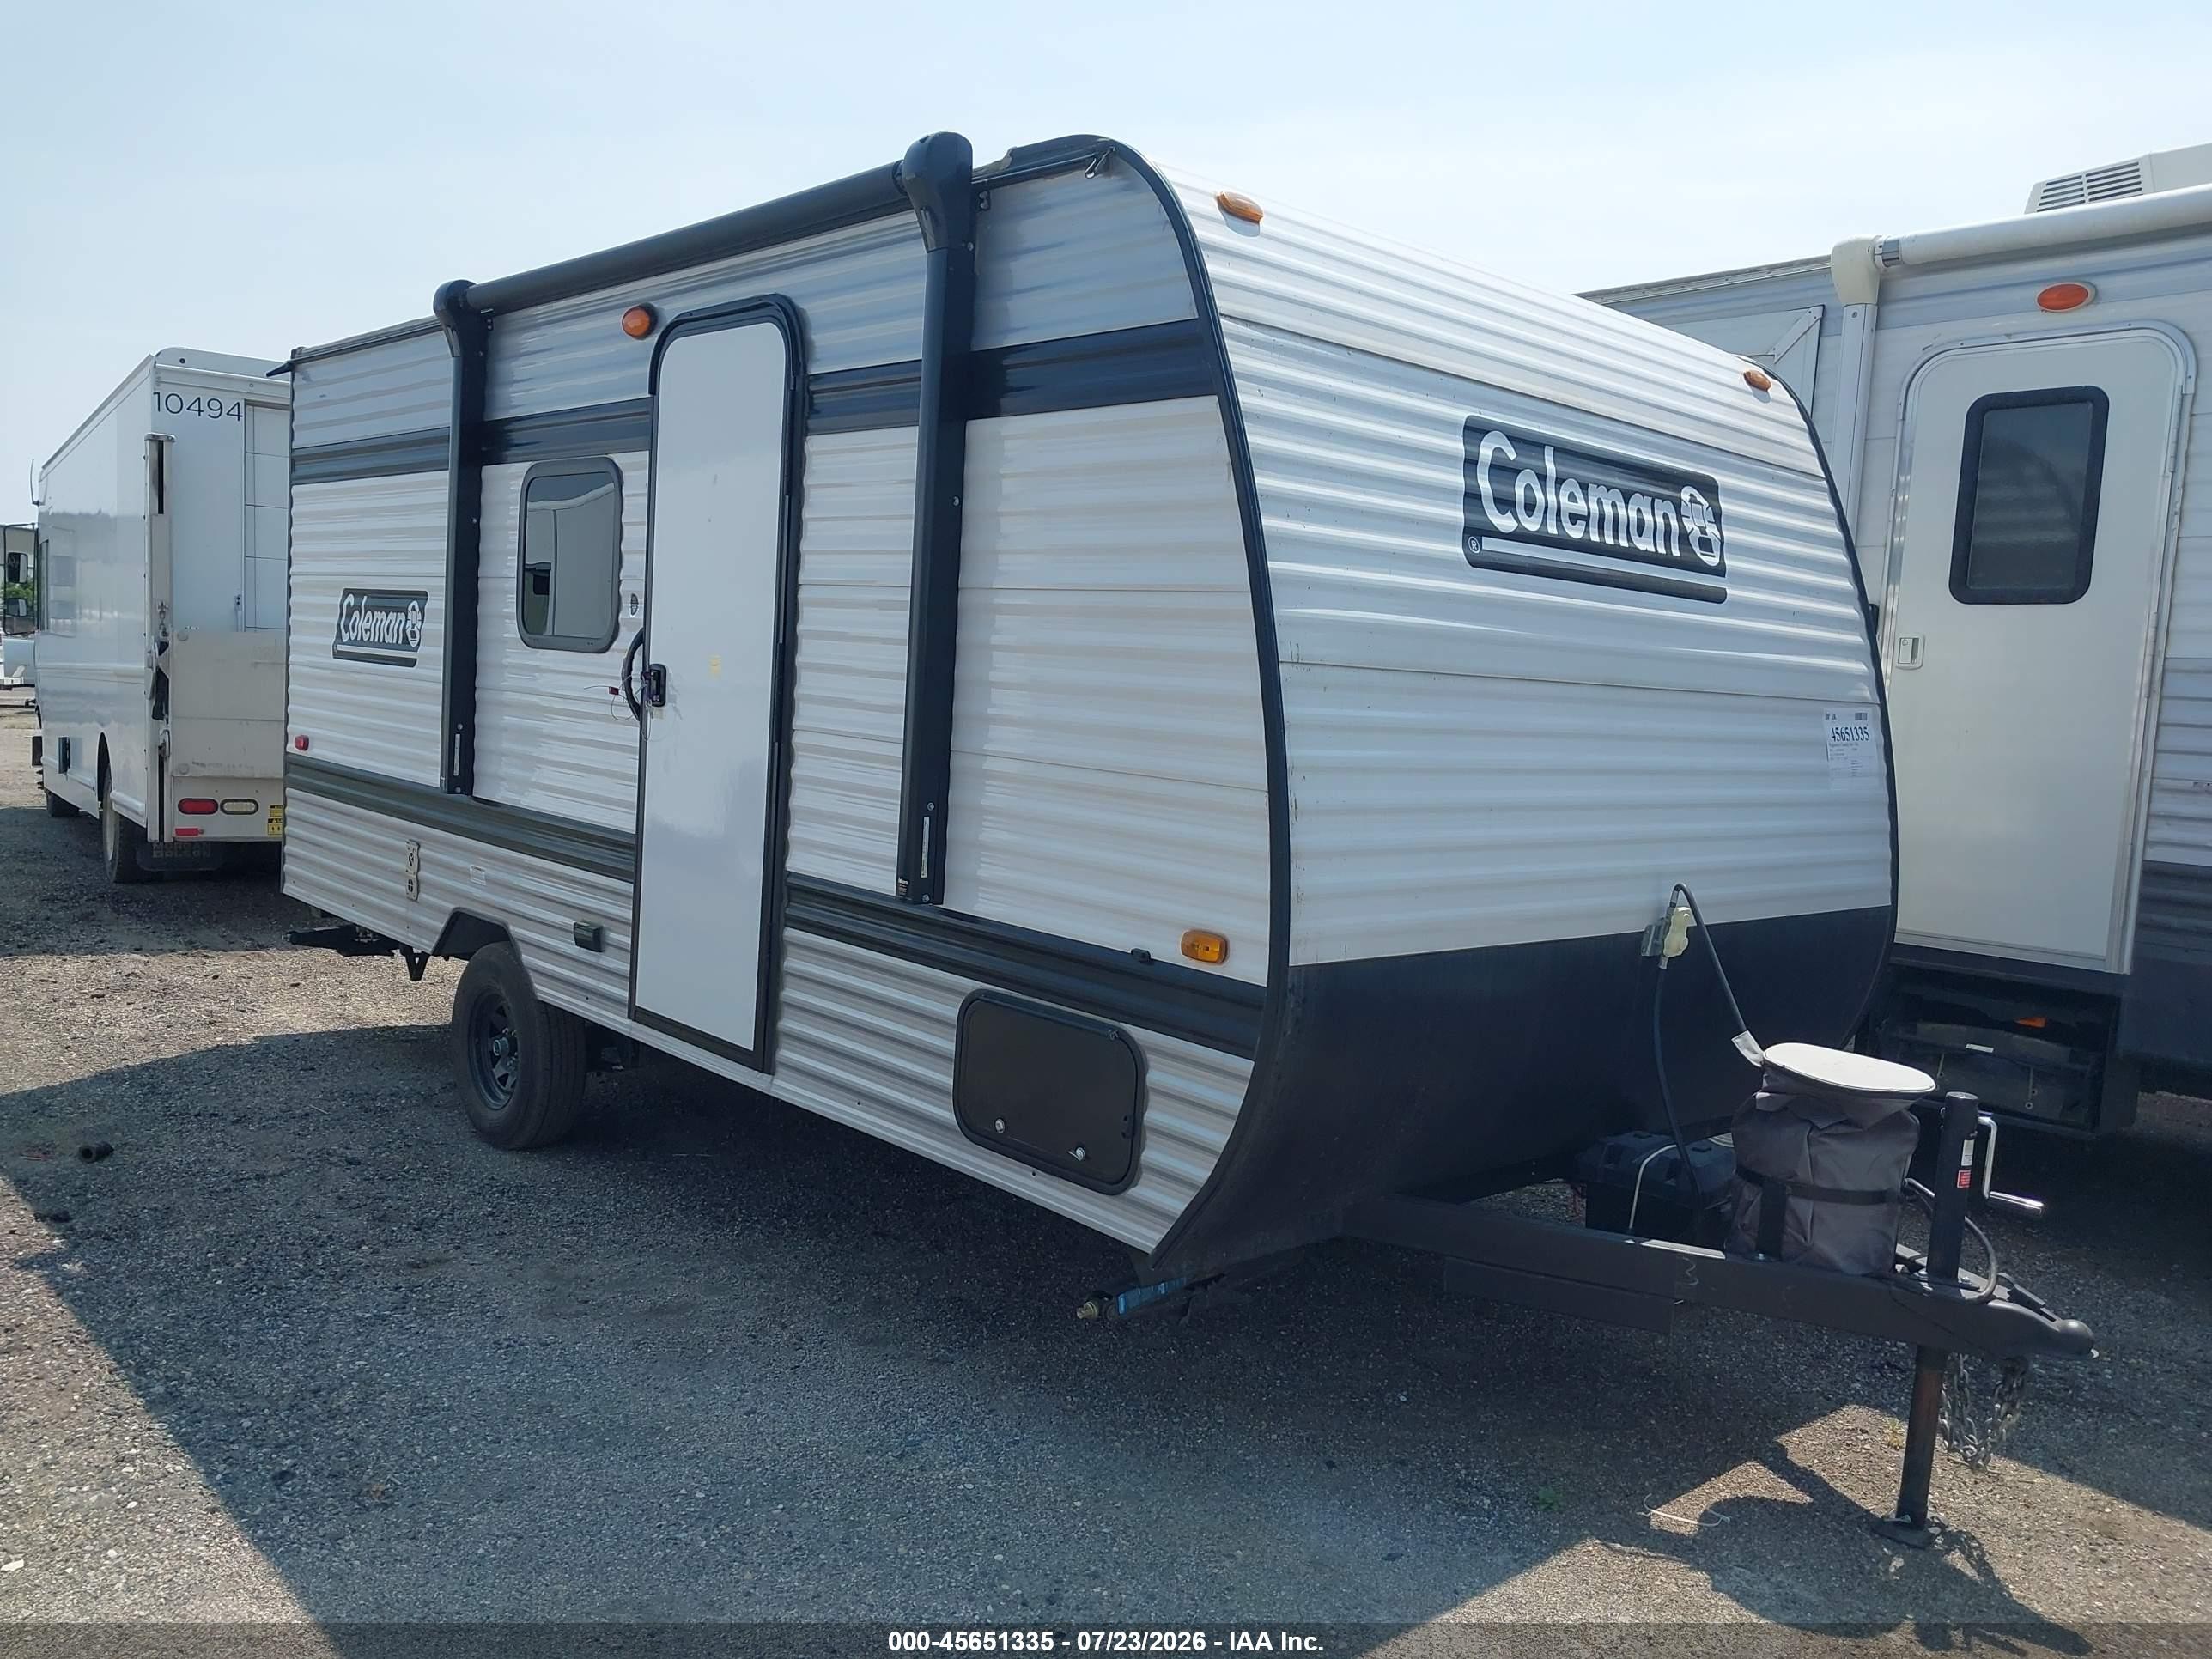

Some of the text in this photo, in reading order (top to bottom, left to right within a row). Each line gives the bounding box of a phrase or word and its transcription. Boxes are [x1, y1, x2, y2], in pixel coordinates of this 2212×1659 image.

[153, 392, 243, 422] 10494
[1477, 430, 1680, 557] Coleman
[341, 593, 406, 644] Coleman
[1831, 726, 1869, 742] 45651335
